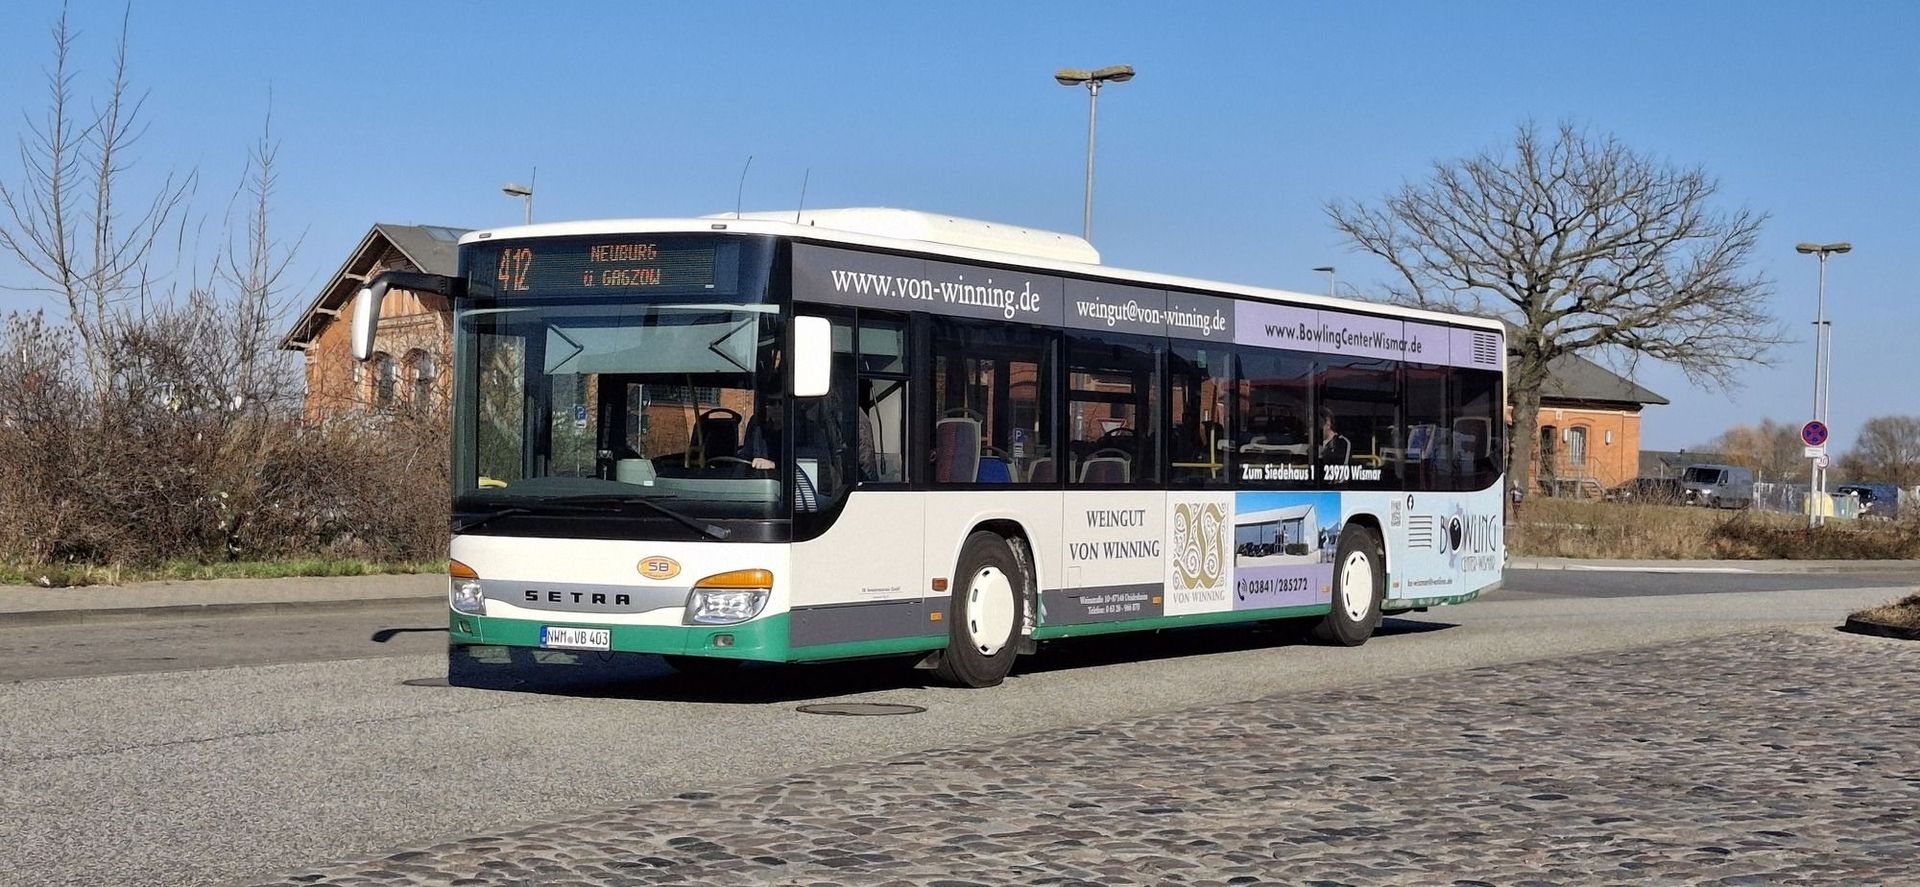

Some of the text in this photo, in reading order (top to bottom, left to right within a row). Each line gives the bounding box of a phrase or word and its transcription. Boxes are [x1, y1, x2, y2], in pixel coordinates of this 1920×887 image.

[590, 243, 657, 263] NEUBURG
[498, 247, 533, 291] 412
[602, 267, 660, 287] GAGZOW
[832, 267, 1041, 318] www.von-winning.de
[1076, 298, 1226, 336] weingut@von-winning.de
[1264, 321, 1422, 354] www.BowlingCenterWismar.de
[1242, 464, 1382, 481] Zum Siedehaus 1 23970 Wismar
[1086, 509, 1146, 528] WEINGUT
[1069, 539, 1160, 561] VON WINNING
[1173, 588, 1226, 604] VON WINNING
[1248, 576, 1309, 596] 03841/285272
[525, 589, 630, 606] SETRA
[547, 629, 609, 646] NWM VB 403
